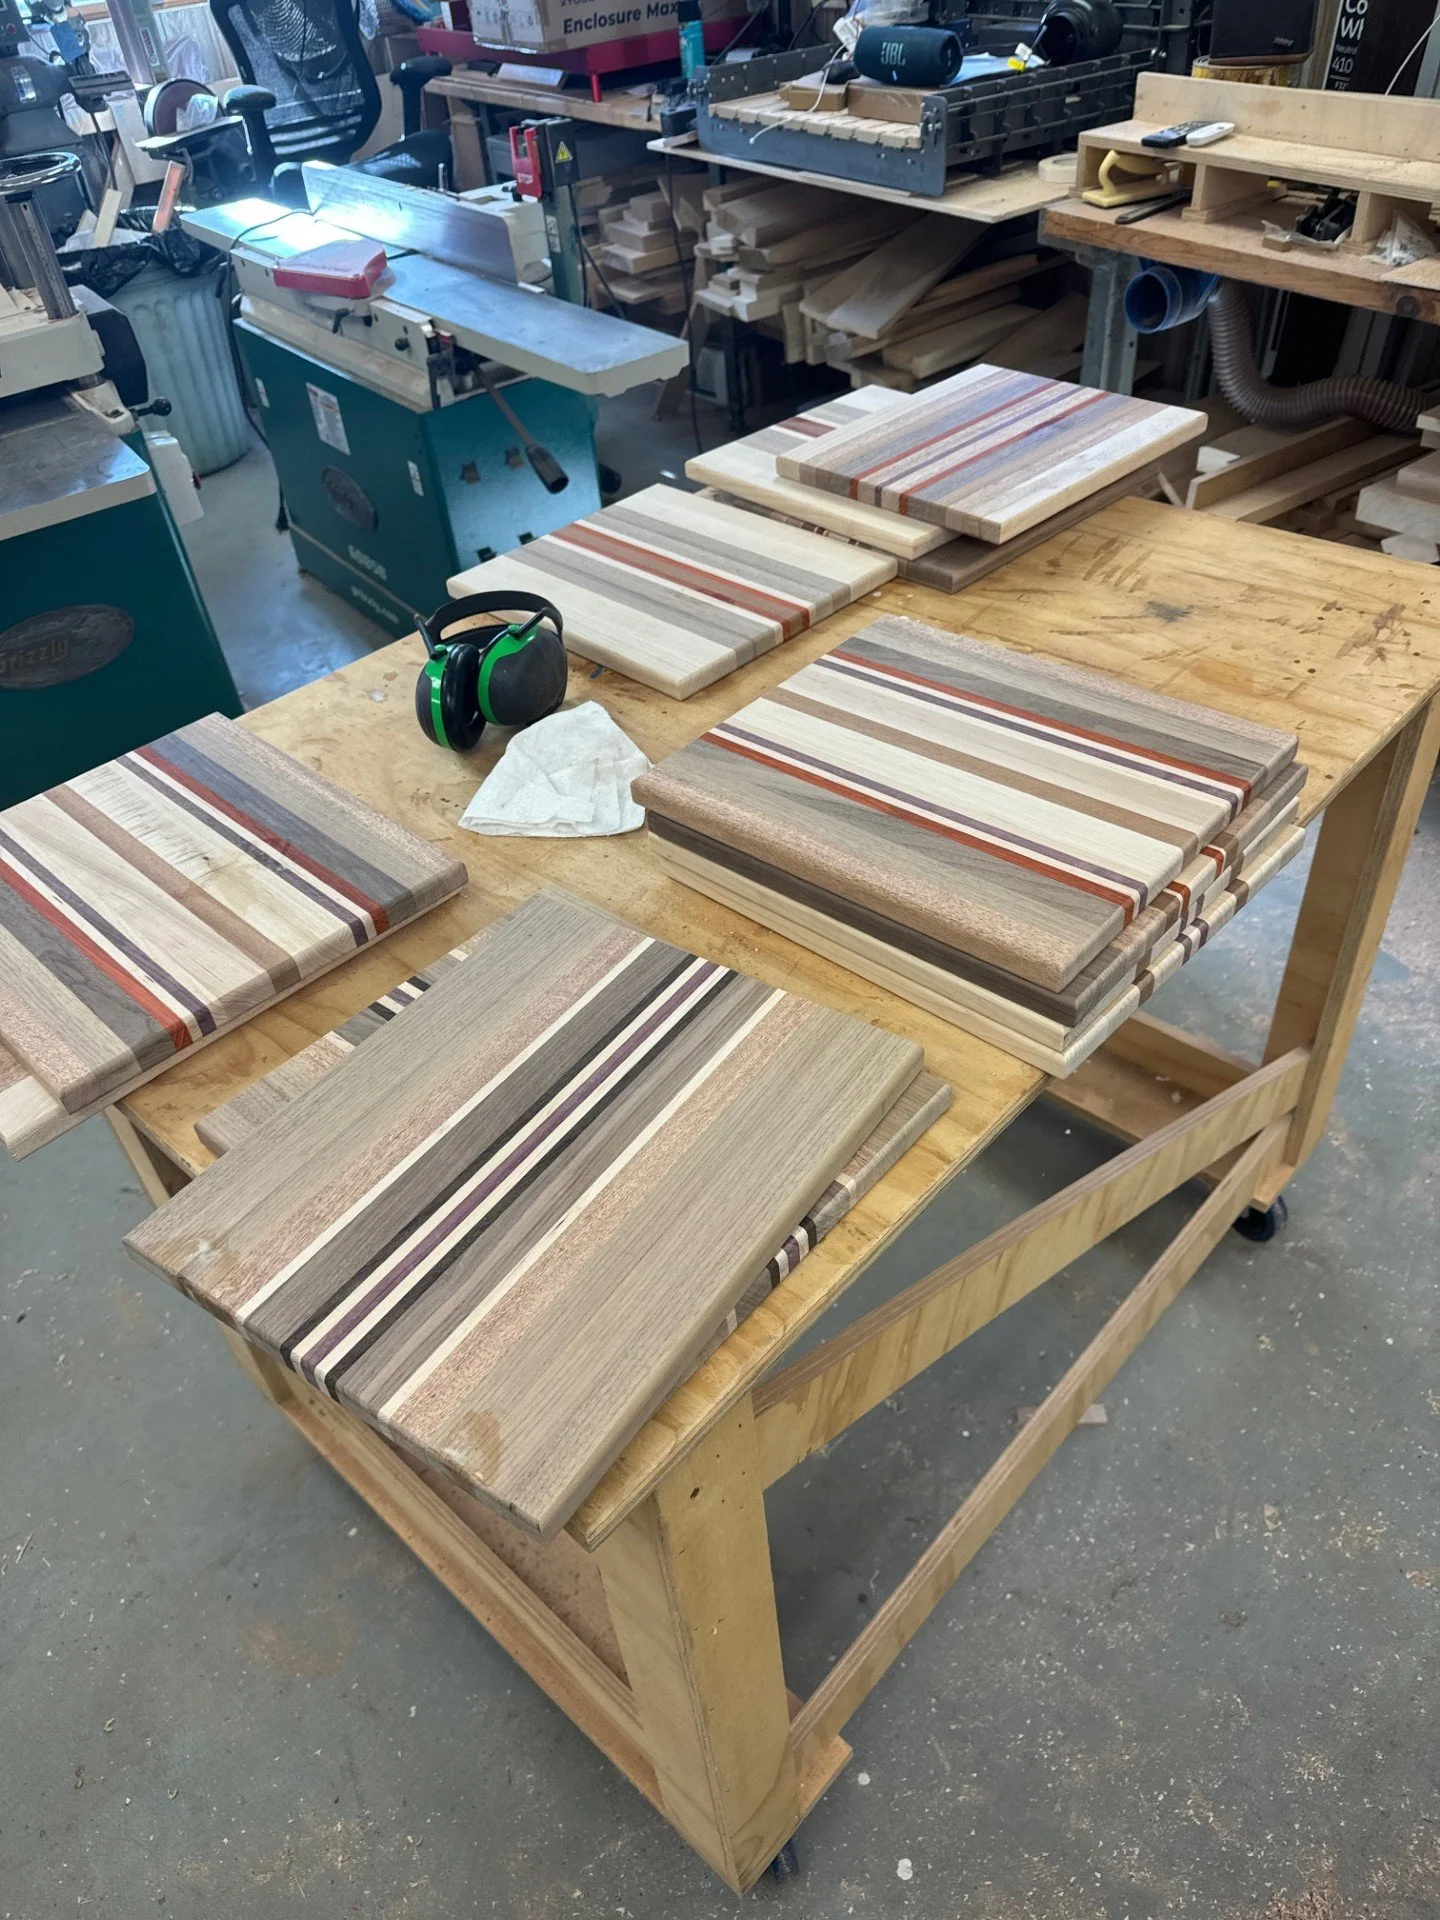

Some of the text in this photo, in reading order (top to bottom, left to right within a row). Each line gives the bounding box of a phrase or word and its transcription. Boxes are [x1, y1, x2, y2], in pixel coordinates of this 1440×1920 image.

[563, 2, 679, 35] Enclosure Max
[880, 41, 906, 66] JBL
[1331, 56, 1354, 74] 410
